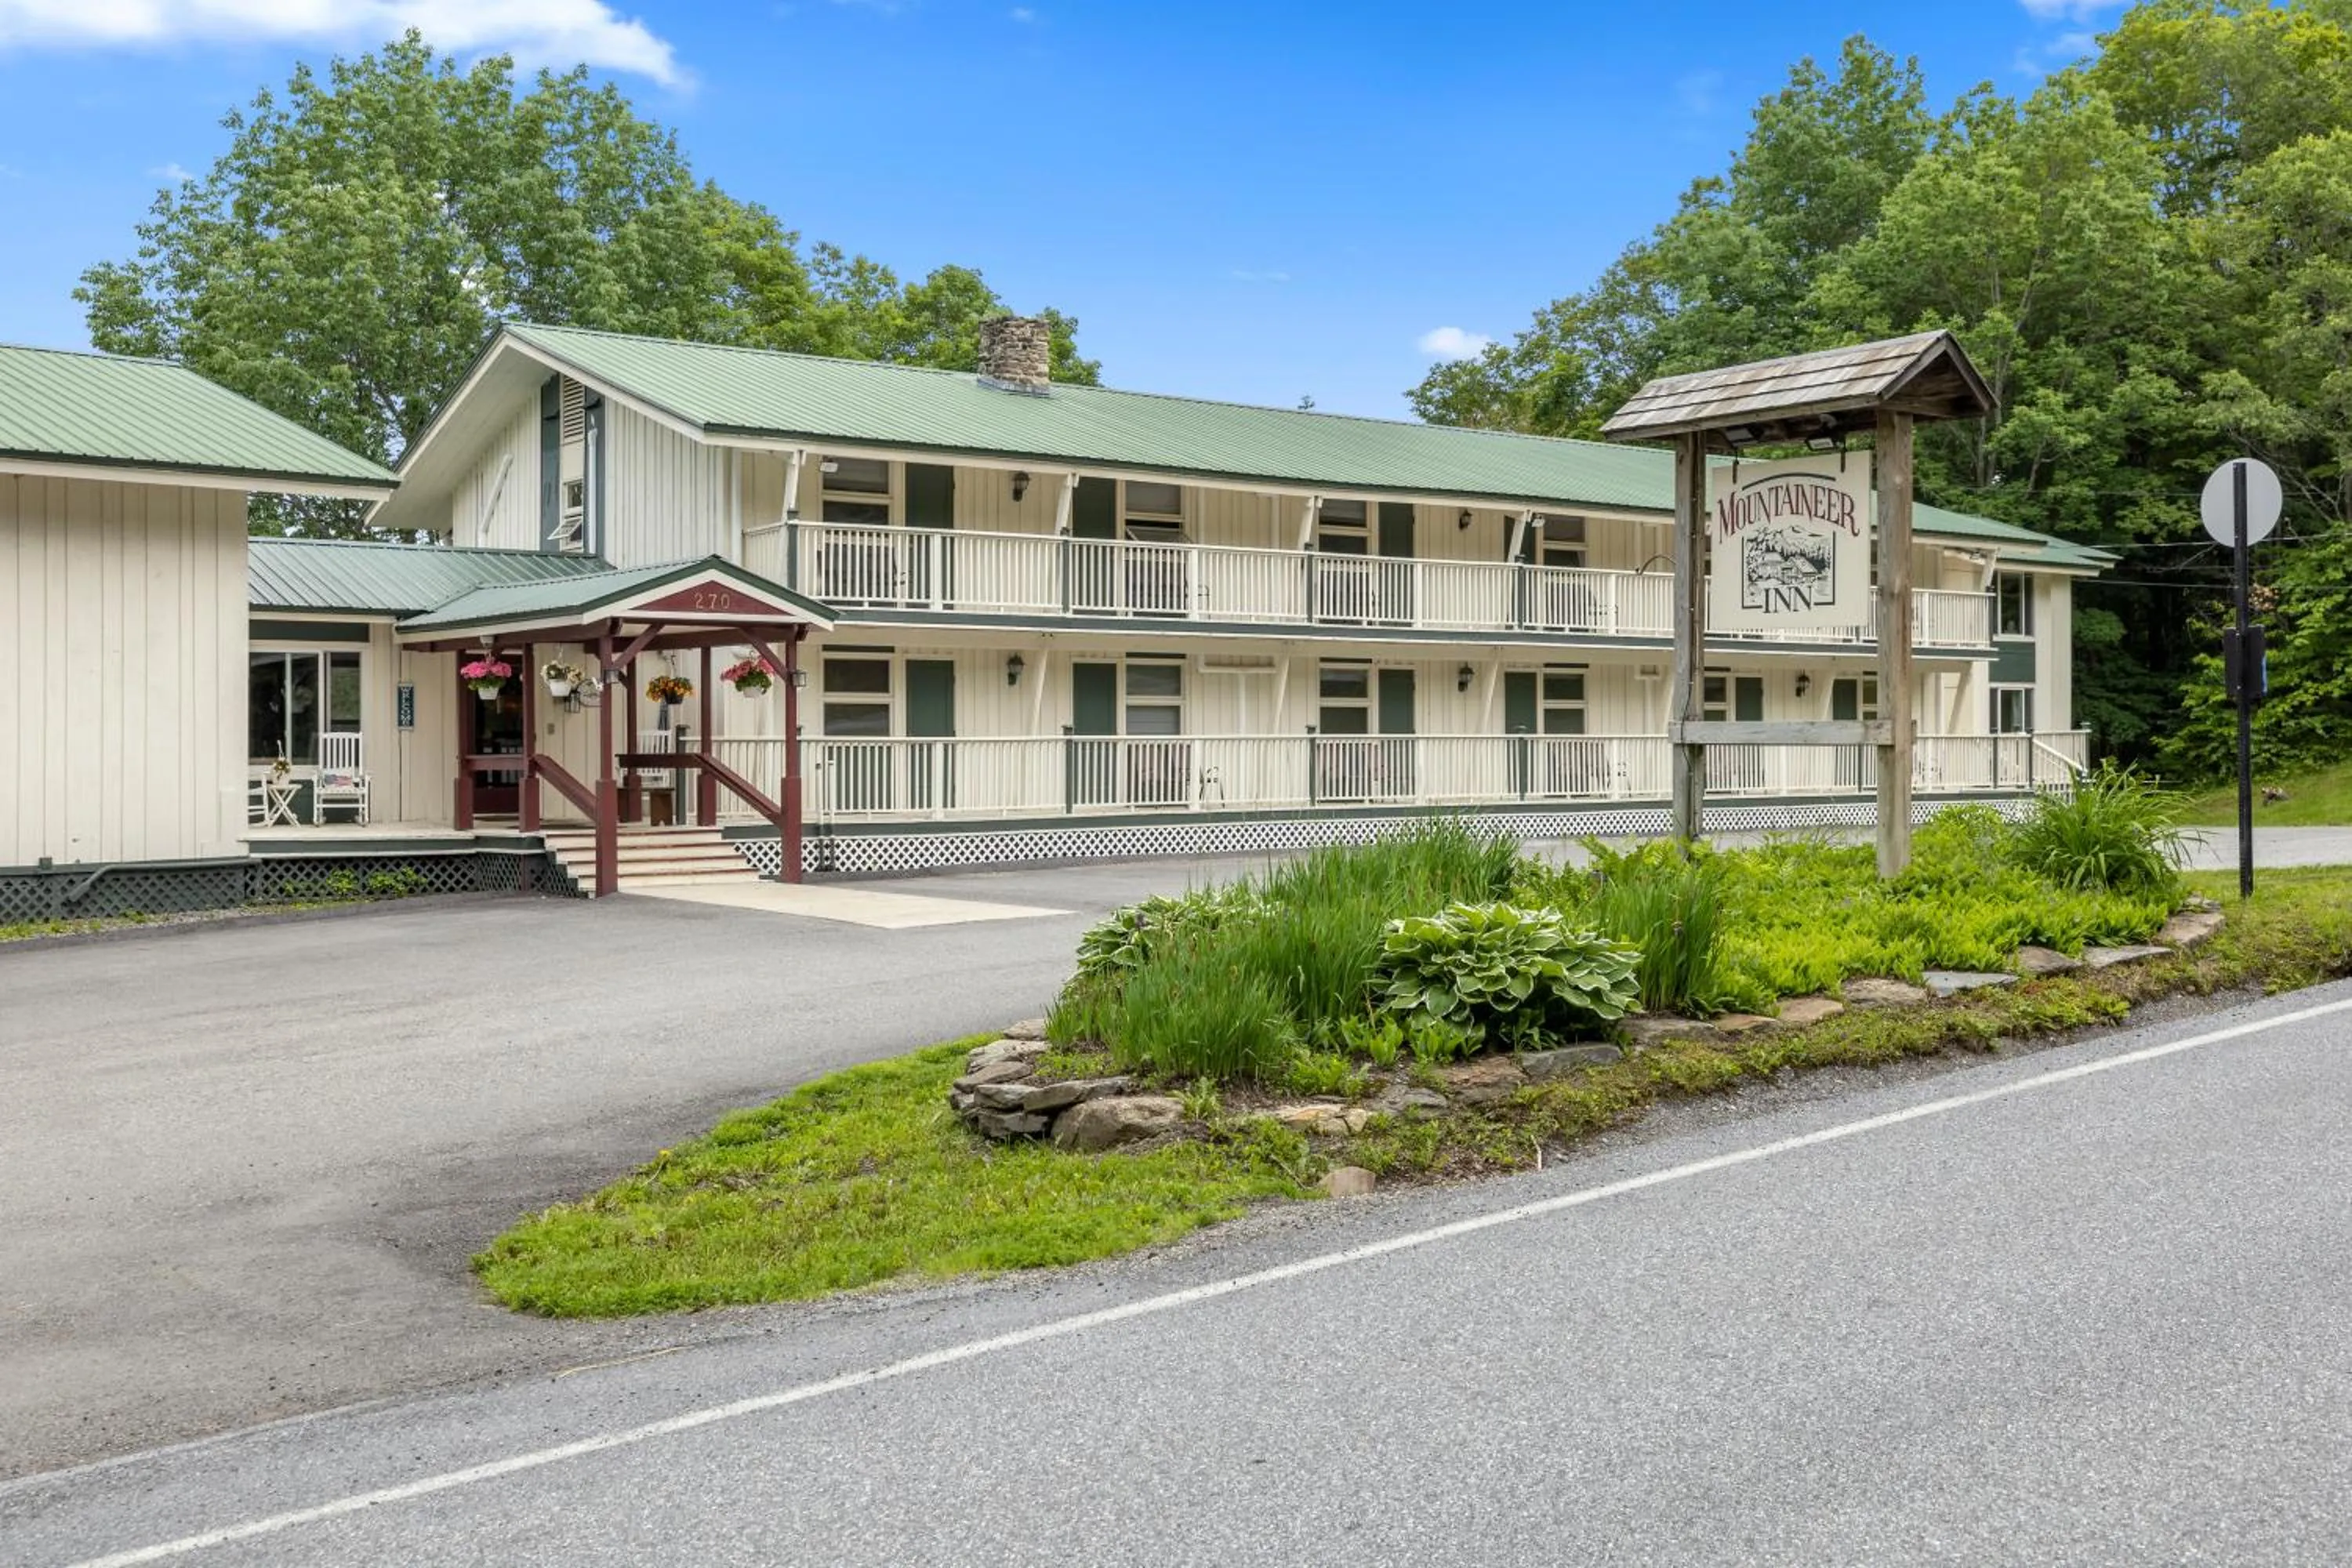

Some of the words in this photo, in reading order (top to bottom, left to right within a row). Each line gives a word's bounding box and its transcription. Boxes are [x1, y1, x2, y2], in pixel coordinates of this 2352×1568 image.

[1717, 483, 1860, 544] MOUNTAINEER
[695, 593, 730, 609] 270
[1763, 586, 1813, 613] INN
